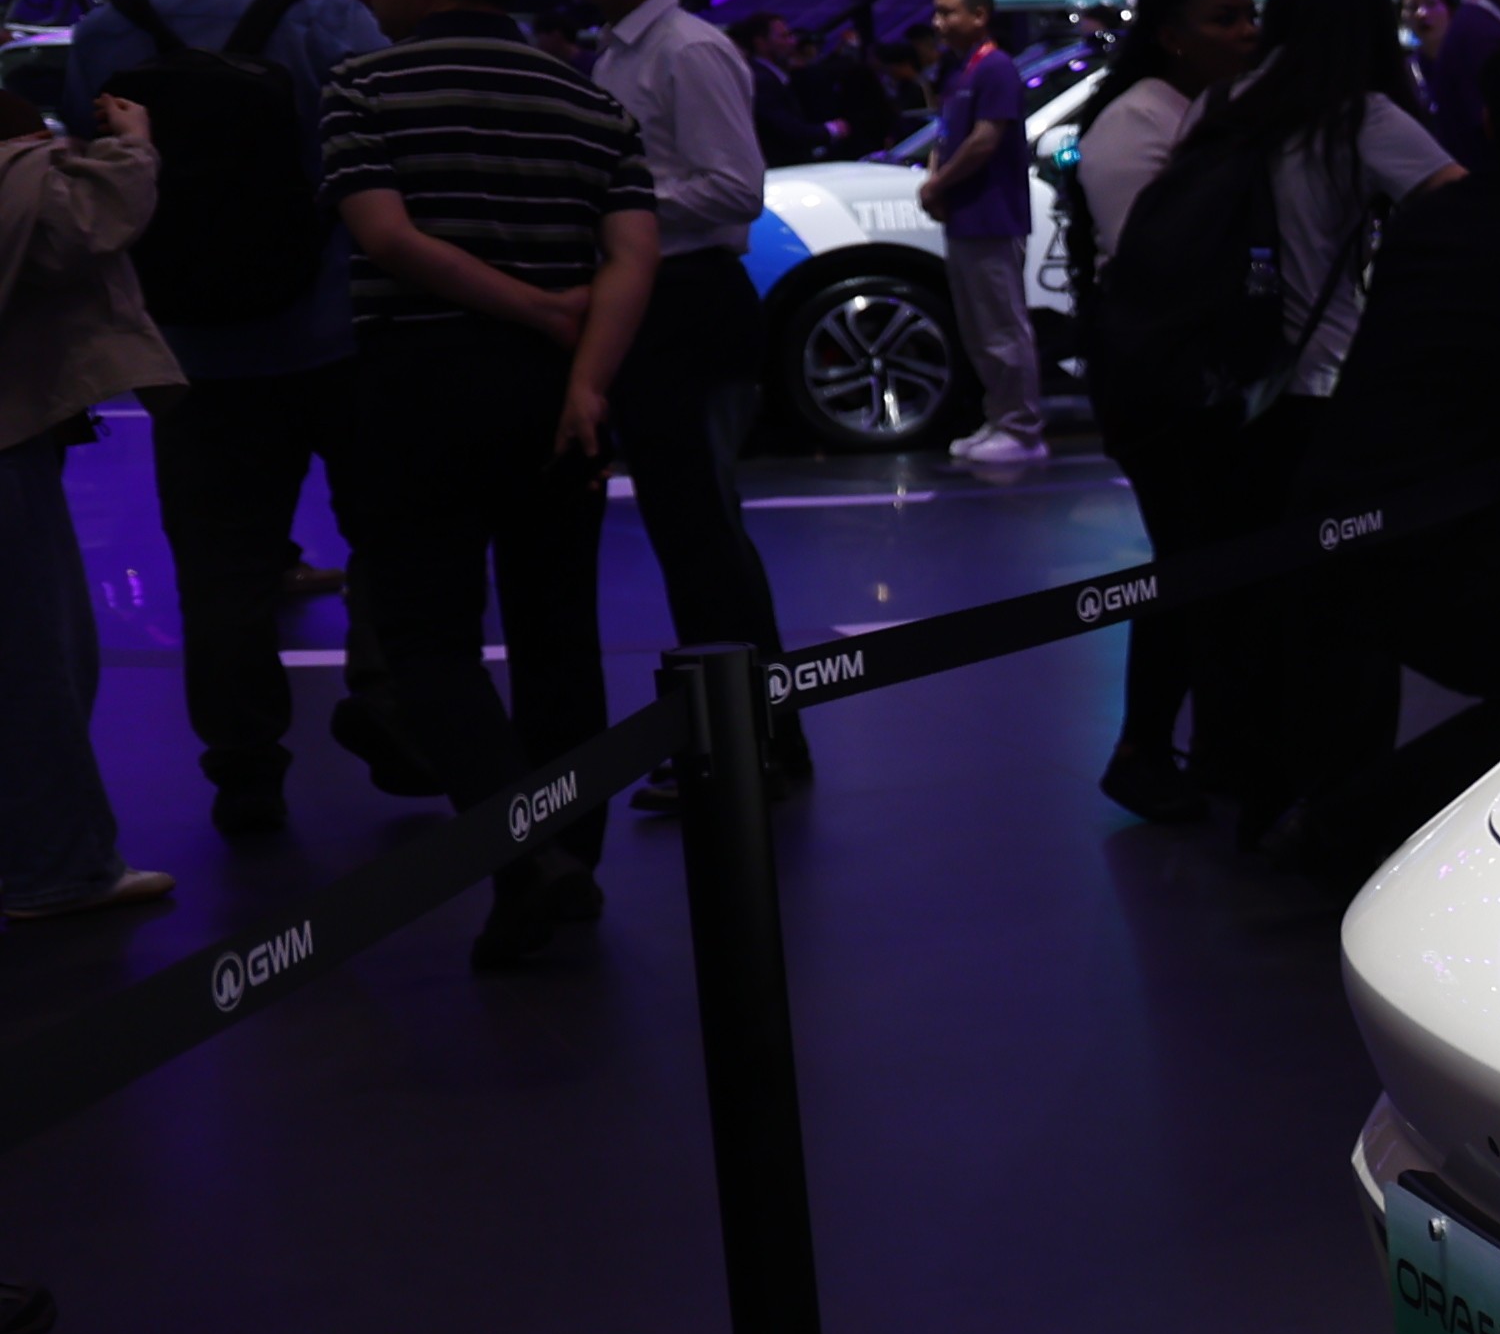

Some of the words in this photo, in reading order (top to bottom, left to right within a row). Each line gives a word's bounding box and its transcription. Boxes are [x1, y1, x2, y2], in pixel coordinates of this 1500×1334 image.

[1341, 510, 1382, 542] GWM
[1104, 576, 1157, 611] GWM
[795, 650, 864, 694] GWM
[533, 770, 577, 825] GWM
[248, 920, 313, 988] GWM
